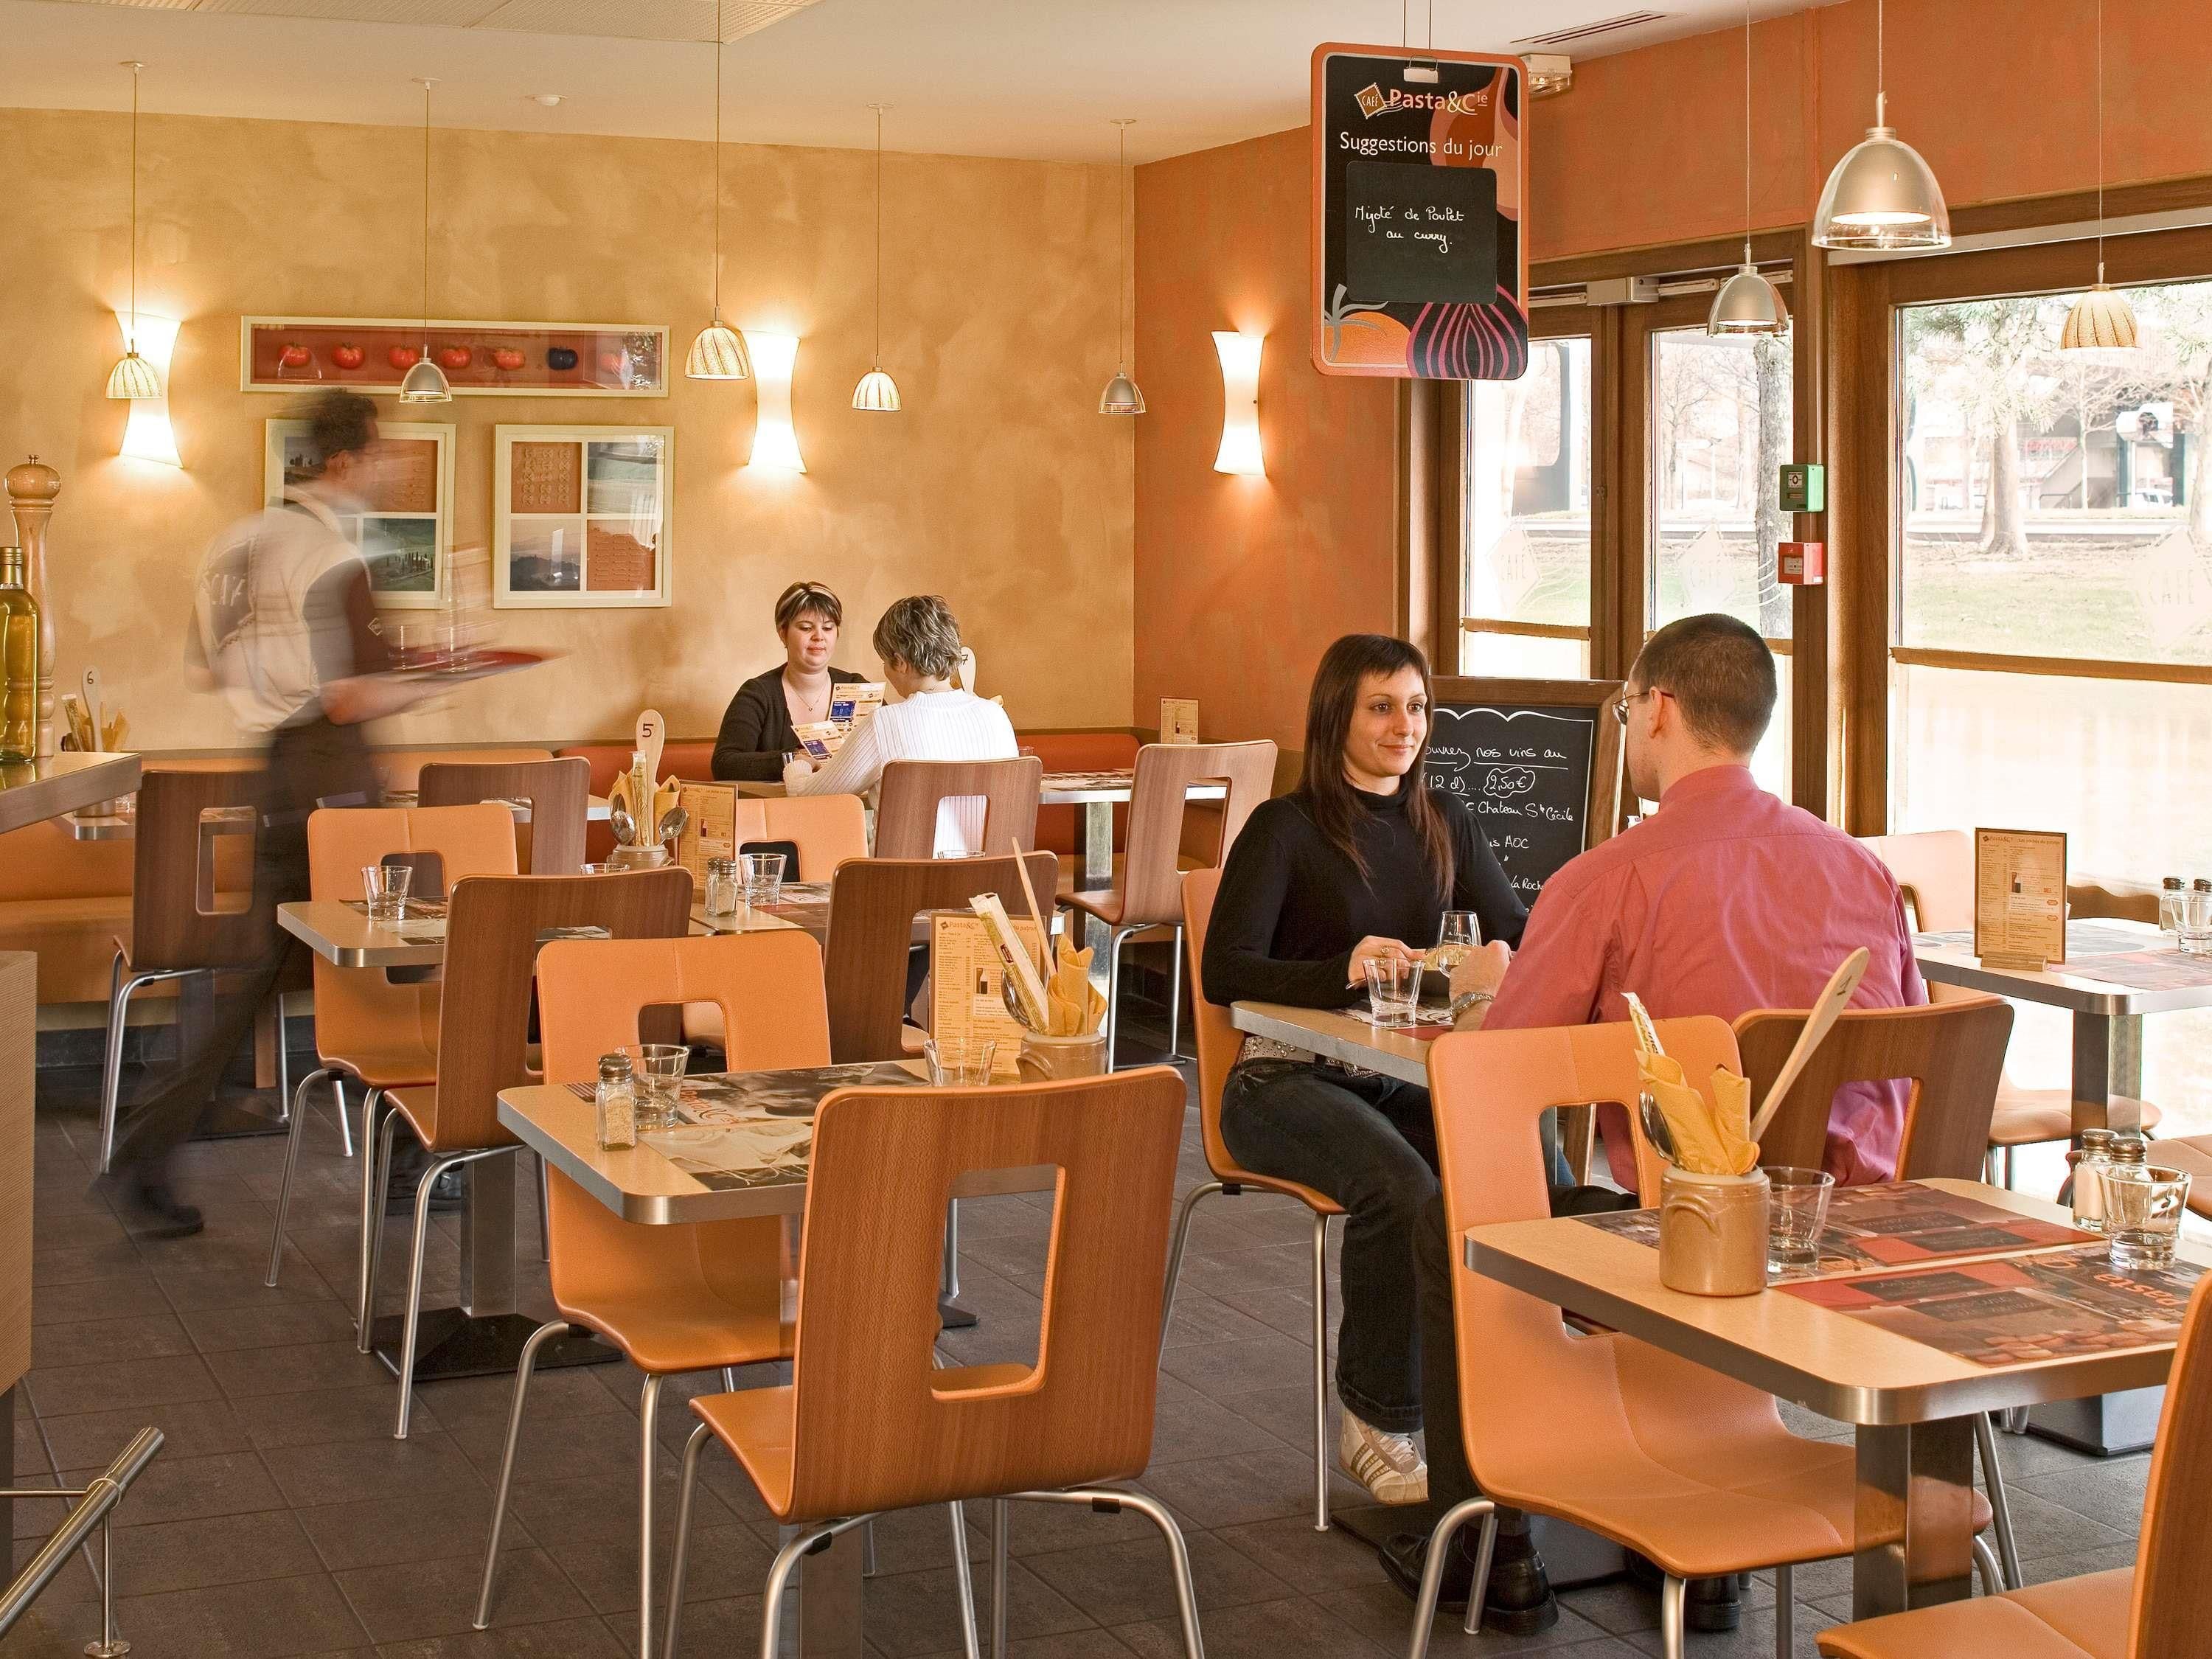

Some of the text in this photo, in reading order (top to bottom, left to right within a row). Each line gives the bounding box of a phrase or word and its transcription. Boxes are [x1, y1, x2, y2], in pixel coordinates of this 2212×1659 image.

[1361, 94, 1379, 108] CAFÉ
[1340, 131, 1503, 161] Suggestions du jour
[1405, 208, 1420, 220] de
[1385, 230, 1405, 239] au
[961, 654, 969, 666] 7
[87, 670, 94, 684] 6
[641, 723, 655, 738] 5
[1475, 747, 1501, 758] nos
[1509, 748, 1537, 757] vins
[1543, 751, 1568, 759] au
[1505, 835, 1530, 849] AOC
